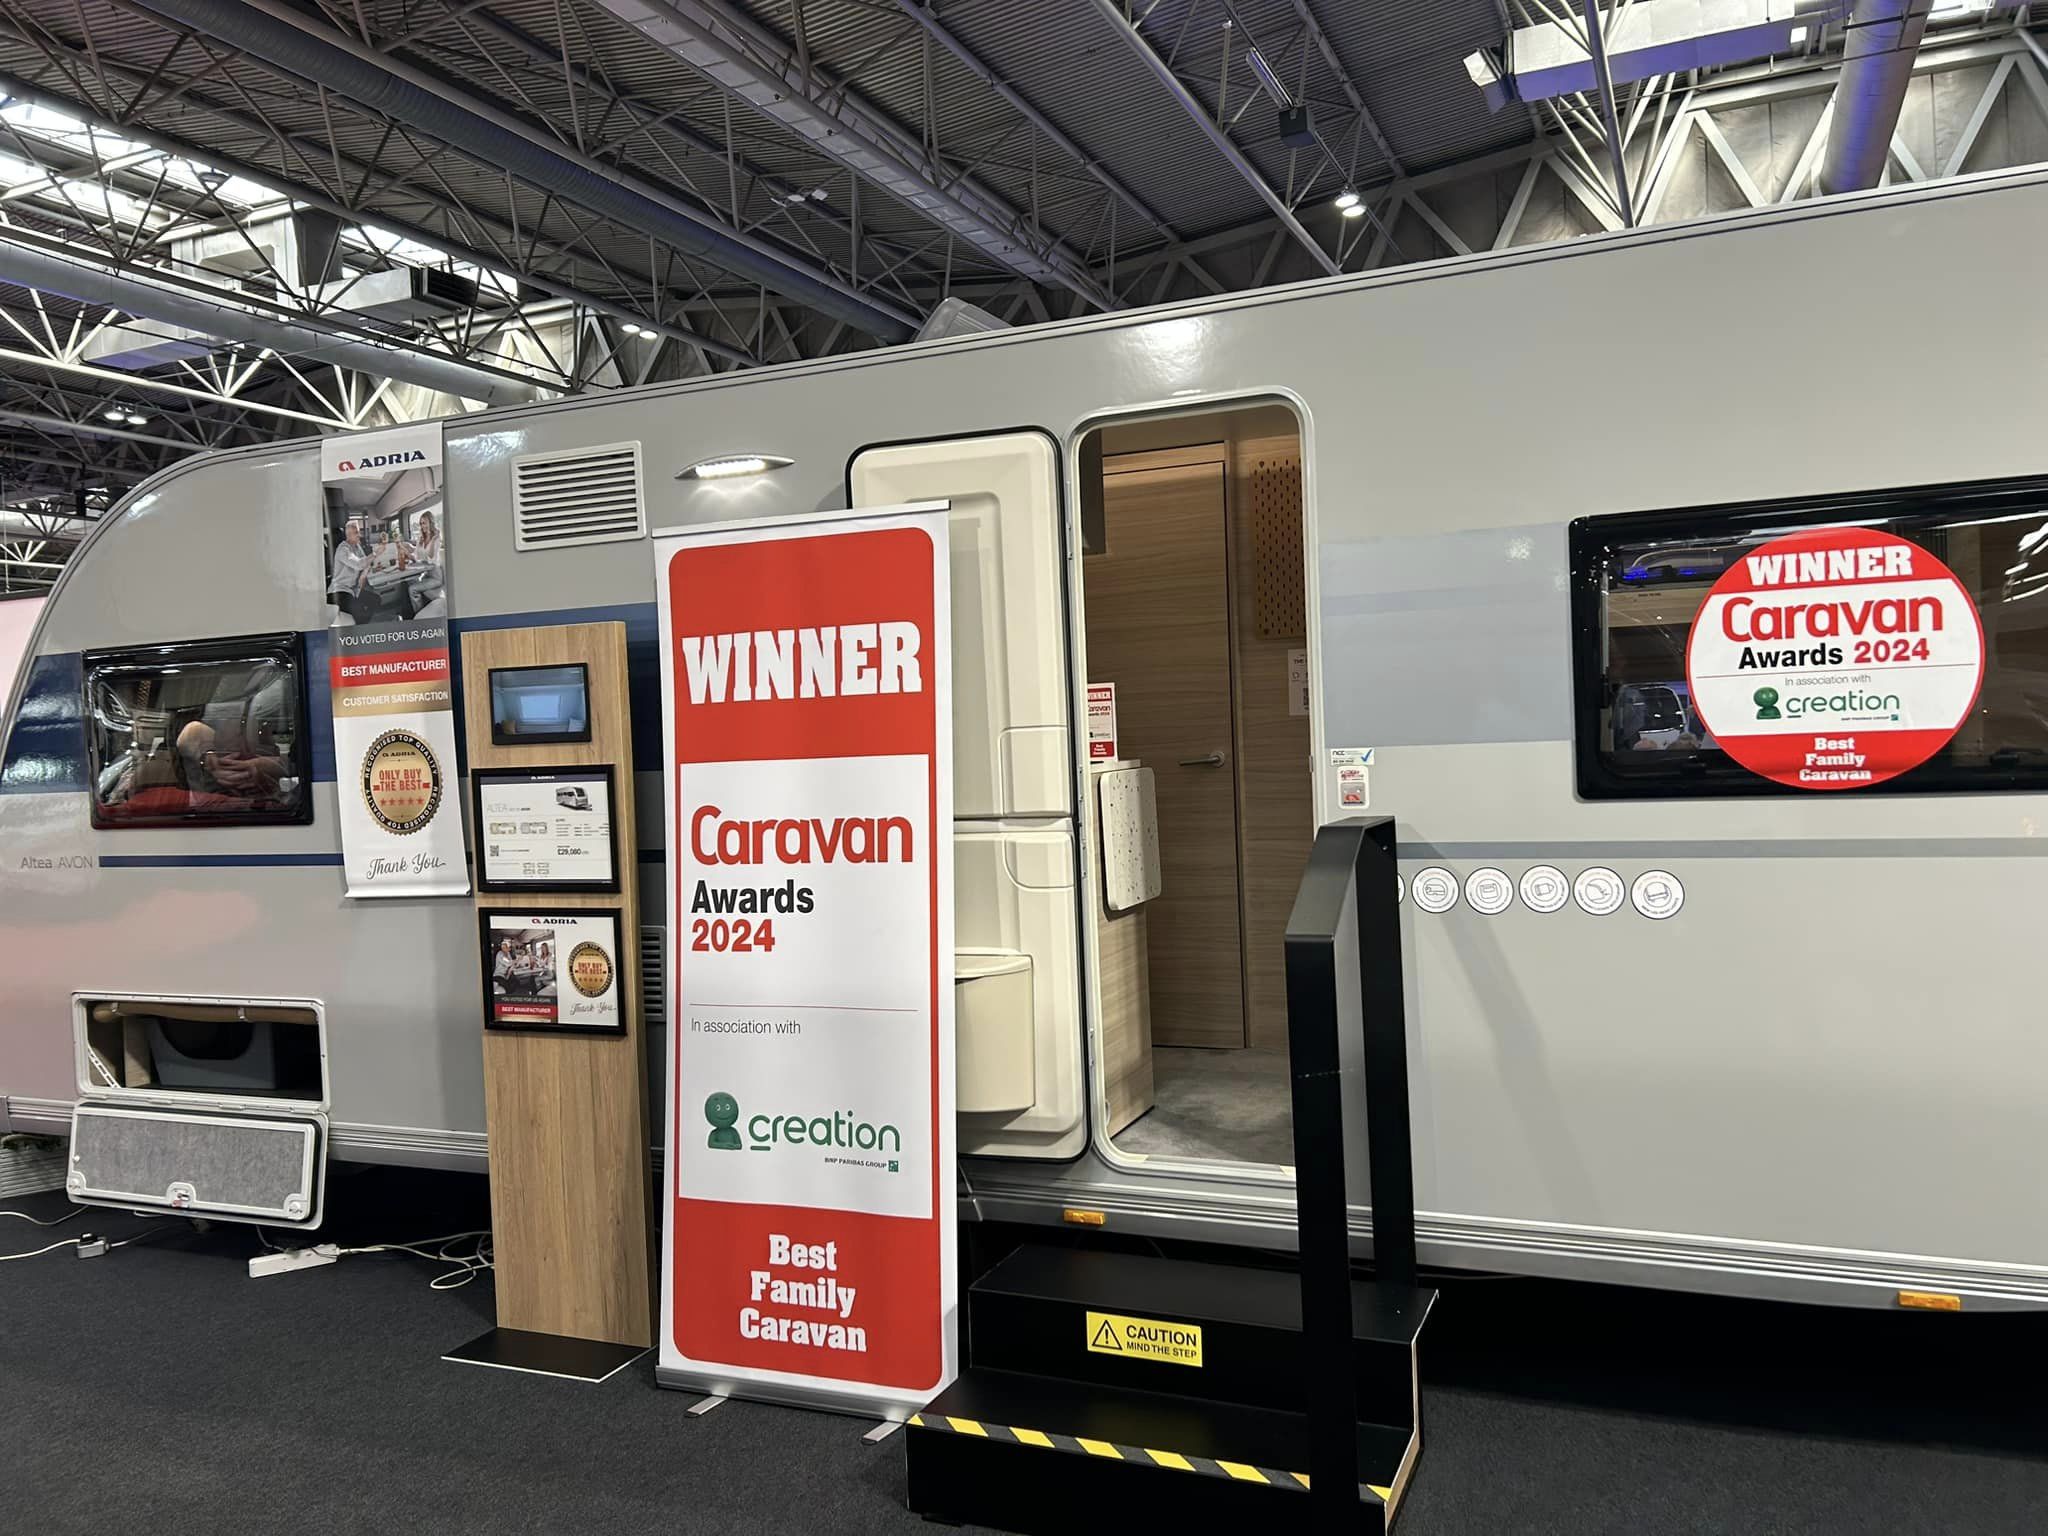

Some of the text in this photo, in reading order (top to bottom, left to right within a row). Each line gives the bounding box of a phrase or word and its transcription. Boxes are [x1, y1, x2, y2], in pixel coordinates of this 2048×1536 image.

[359, 450, 426, 469] ADRIA
[1746, 545, 1913, 586] WINNER
[1722, 596, 1943, 642] Caravan
[340, 628, 445, 646] YOU VOTED FOR US AGAIN
[682, 621, 922, 704] WINNER
[1738, 638, 1930, 670] Awards 2024
[341, 658, 447, 677] BEST MANUFACTURER
[1785, 674, 1871, 686] In association with
[343, 691, 448, 707] CUSTOMER SATISFACTION
[1786, 689, 1900, 713] creation
[1814, 737, 1855, 750] Best
[365, 734, 439, 778] RECOGNISED TOP QUALITY
[1805, 753, 1866, 767] Family
[379, 768, 422, 781] ONLY BUY
[380, 779, 422, 792] THE BEST
[1799, 769, 1872, 782] Caravan
[404, 786, 438, 829] RECOGNISED
[691, 805, 913, 866] Caravan
[20, 855, 94, 869] Altea AVON
[366, 852, 447, 880] Thank You
[691, 879, 815, 914] Awards
[691, 918, 776, 953] 2024
[691, 1018, 801, 1034] In association with
[748, 1110, 901, 1152] creation
[865, 1160, 887, 1168] GROUP
[769, 1233, 837, 1271] Best
[751, 1270, 856, 1319] Family
[739, 1307, 867, 1352] Caravan
[1126, 1325, 1197, 1347] CAUTION
[1126, 1341, 1197, 1358] MIND THE STEP
